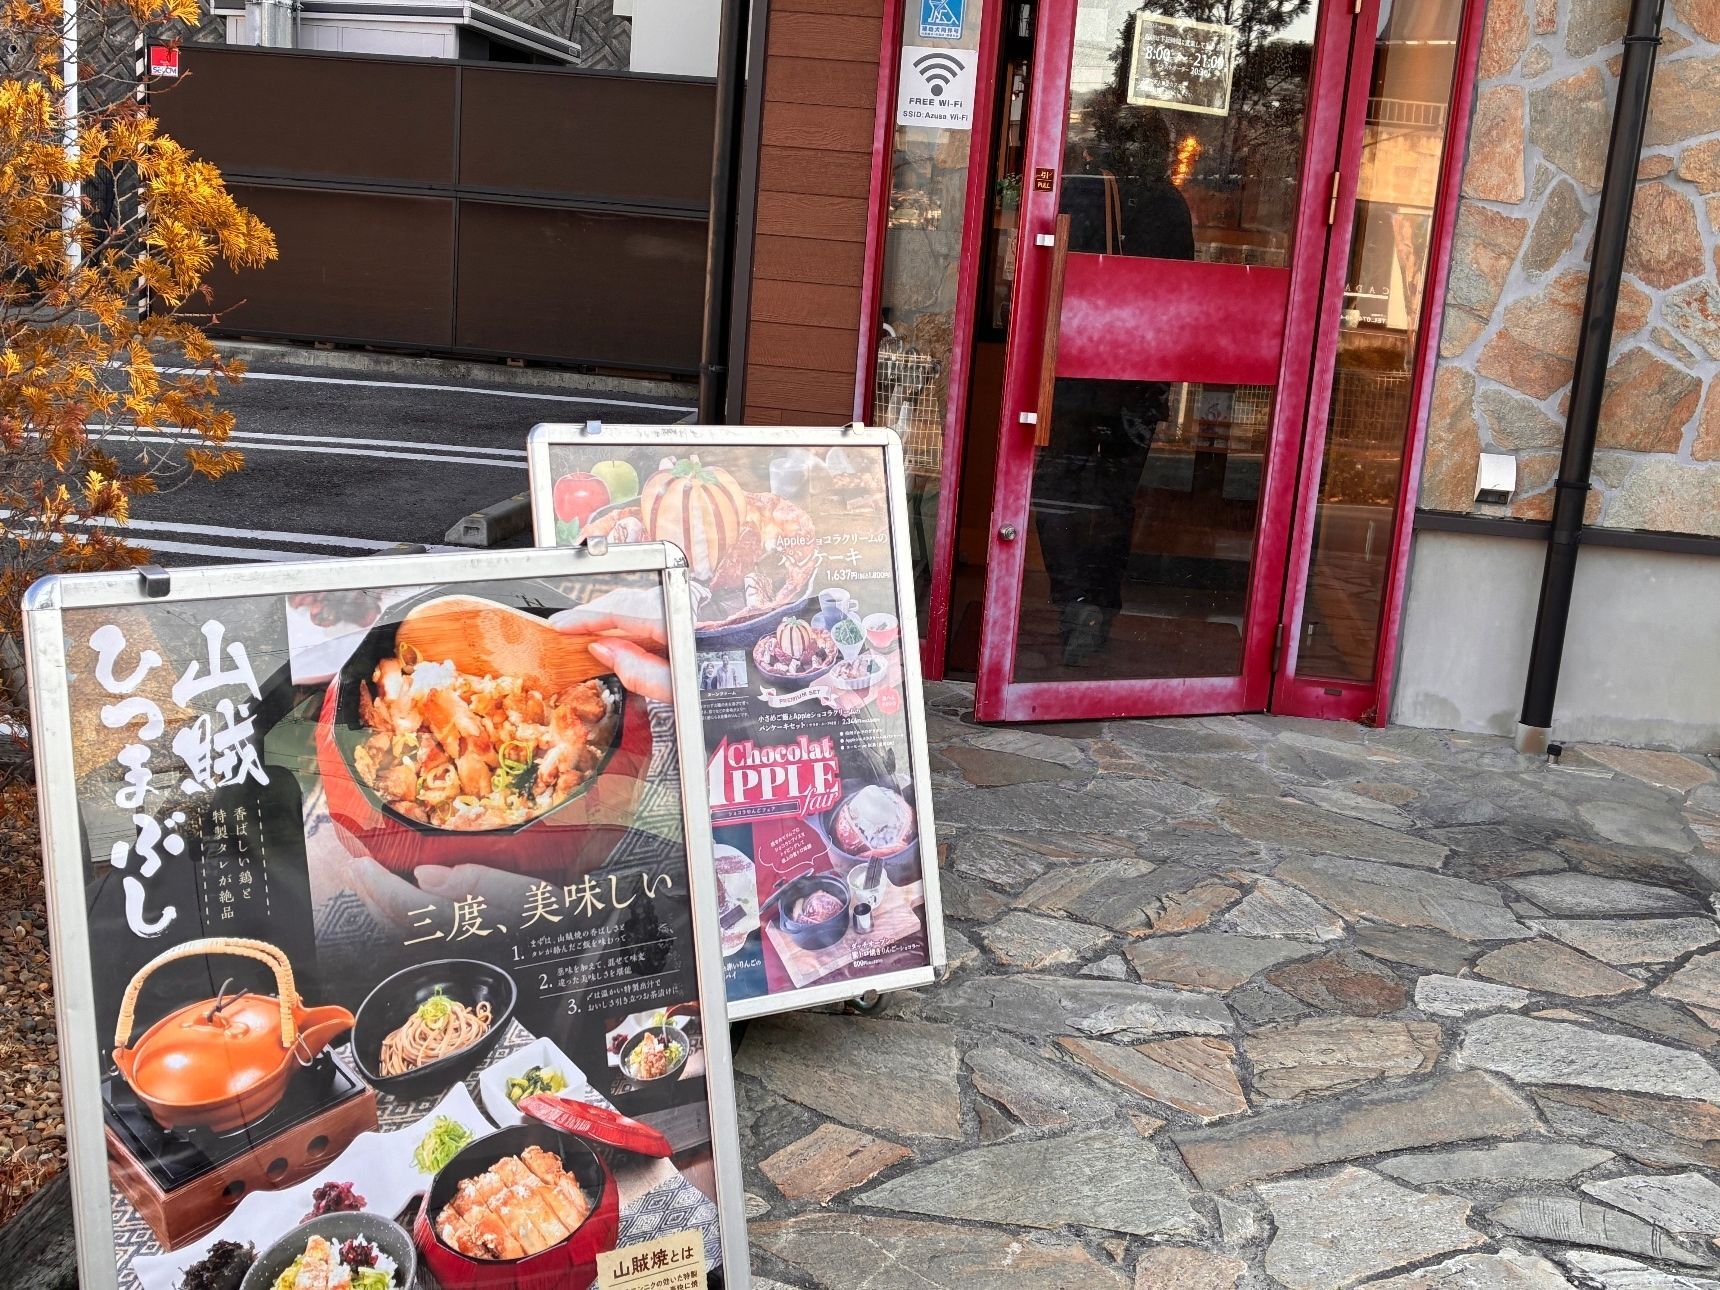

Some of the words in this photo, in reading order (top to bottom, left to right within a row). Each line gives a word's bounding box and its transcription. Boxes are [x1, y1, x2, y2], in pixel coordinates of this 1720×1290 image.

[1146, 45, 1171, 60] 8:00
[1193, 53, 1224, 70] 21:00
[909, 97, 935, 106] FREE
[938, 99, 963, 108] Wi-Fi
[776, 533, 888, 547] Appleショコラクリームの
[777, 547, 863, 567] パンケーキ
[172, 619, 270, 795] 山賊
[780, 691, 807, 704] PREMIUM
[727, 738, 833, 767] Chocolat
[89, 624, 186, 938] ひつまぶし
[801, 787, 838, 817] fair
[212, 808, 235, 920] 特製タレが絶品
[233, 806, 253, 899] 香ばしい鶏と
[403, 872, 674, 946] 三度、美味しい
[512, 945, 525, 961] 1.
[532, 934, 626, 958] タレが絡んだご飯を味わって
[538, 973, 553, 992] 2.
[567, 998, 581, 1015] 3.
[613, 1245, 694, 1279] 山賊焼とは
[626, 1269, 698, 1290] ニンニクの効いた特製
